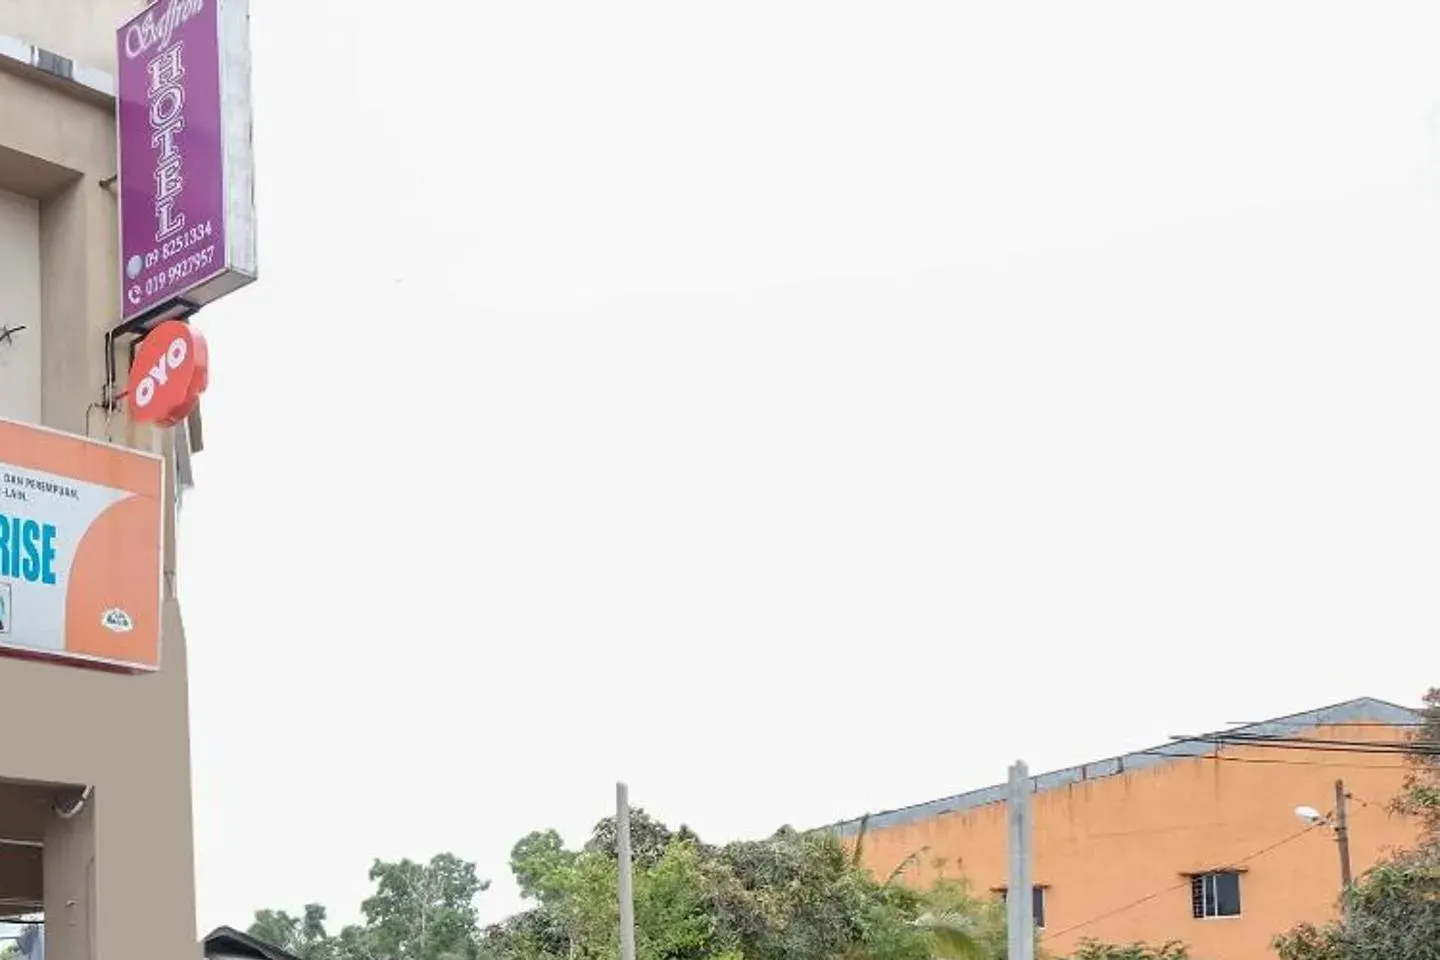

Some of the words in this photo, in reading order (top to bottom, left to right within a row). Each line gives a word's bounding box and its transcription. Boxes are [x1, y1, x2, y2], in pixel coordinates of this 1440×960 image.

[148, 40, 185, 242] HOTEL
[145, 248, 159, 268] 09
[145, 271, 166, 295] 019
[136, 337, 187, 408] OYO
[3, 473, 24, 486] DAN
